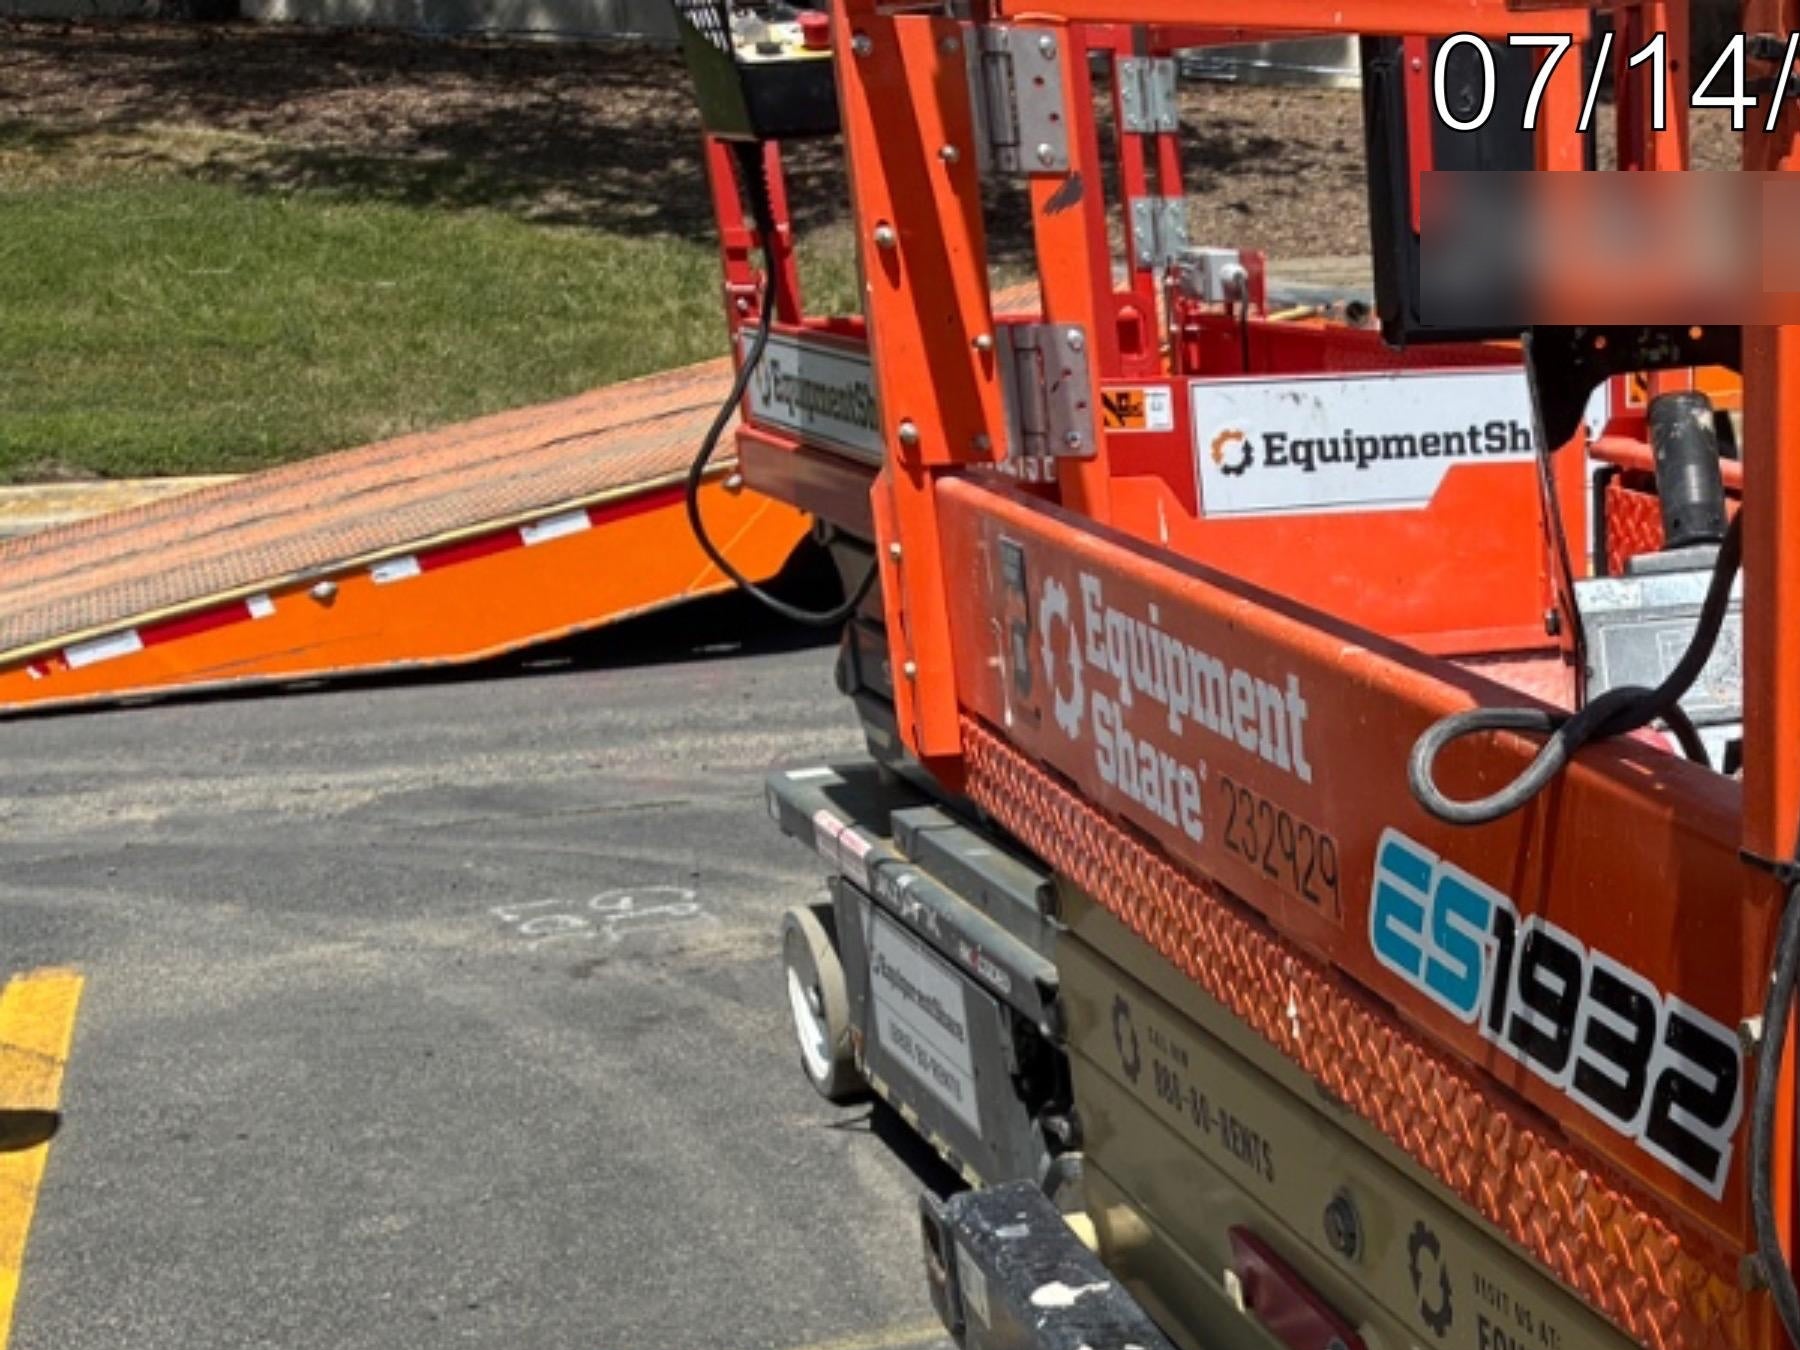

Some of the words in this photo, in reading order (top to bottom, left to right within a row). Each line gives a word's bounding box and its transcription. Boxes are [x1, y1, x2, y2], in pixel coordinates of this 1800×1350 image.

[1261, 419, 1532, 474] EquipmentSh
[1079, 571, 1312, 784] Equipment
[1091, 689, 1206, 843] Share
[1219, 774, 1342, 916] 232929
